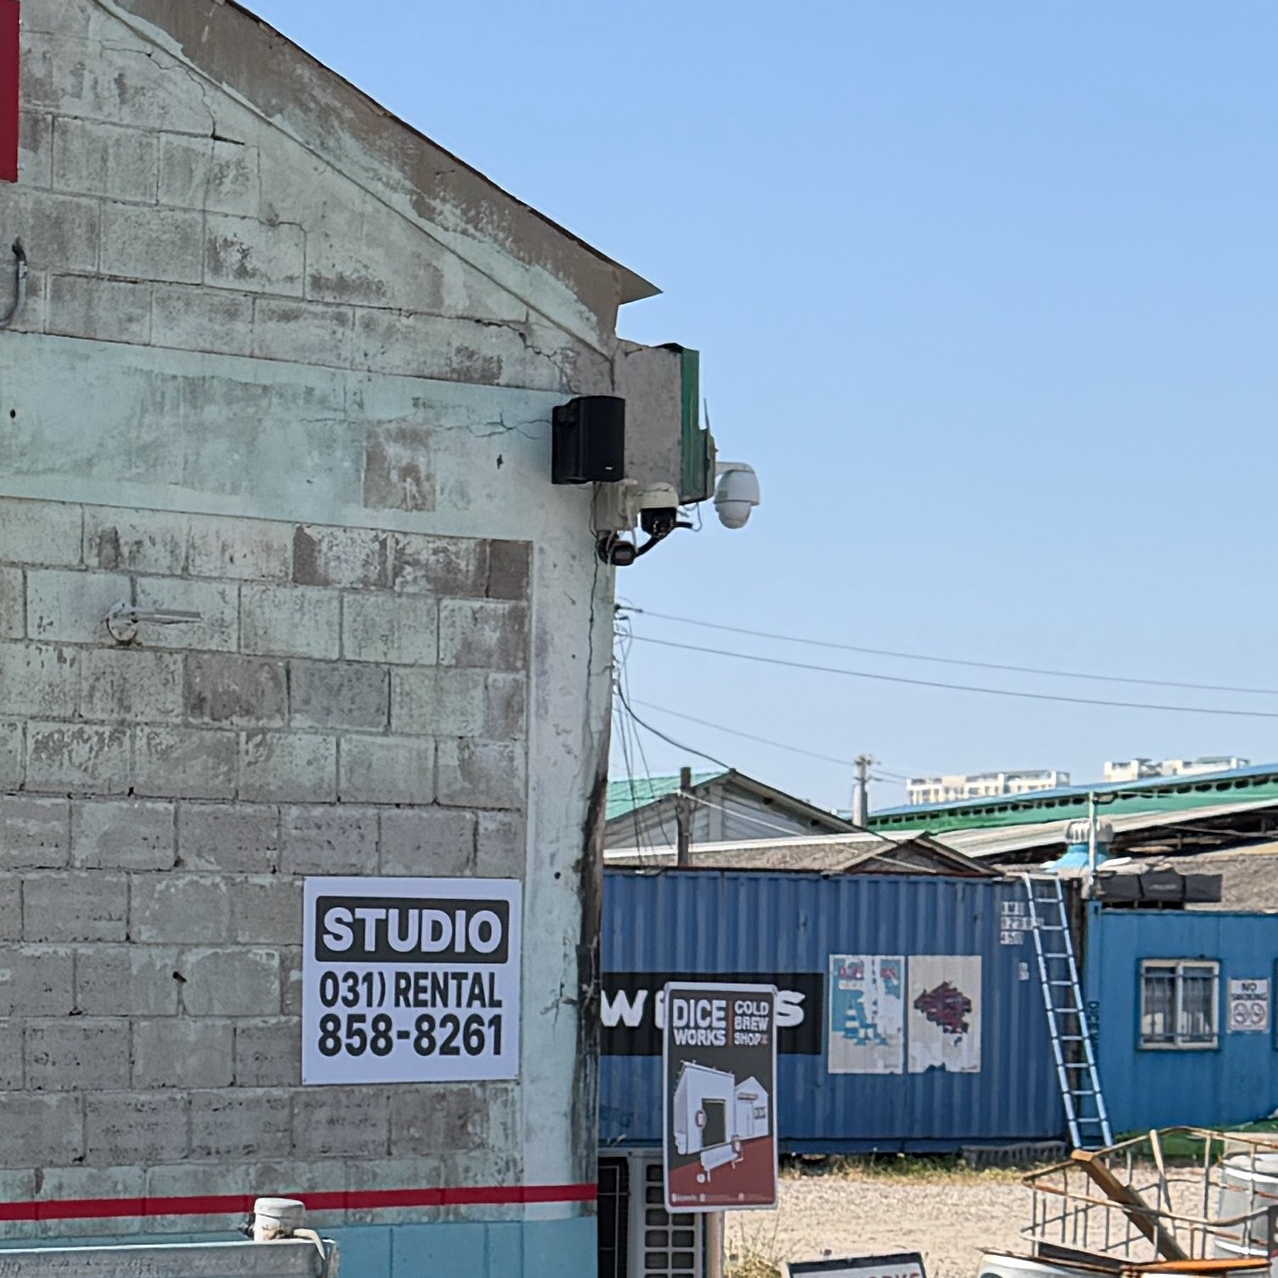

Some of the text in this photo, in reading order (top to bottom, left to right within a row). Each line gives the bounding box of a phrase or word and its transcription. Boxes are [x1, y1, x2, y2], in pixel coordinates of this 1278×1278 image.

[322, 906, 503, 954] STUDIO
[319, 970, 503, 1008] 031) RENTAL
[672, 998, 727, 1028] DICE
[734, 1000, 770, 1015] COLD
[318, 1012, 503, 1058] 858-8261
[734, 1016, 770, 1031] BREW
[673, 1028, 726, 1046] WORKS
[734, 1032, 761, 1046] SHOP
